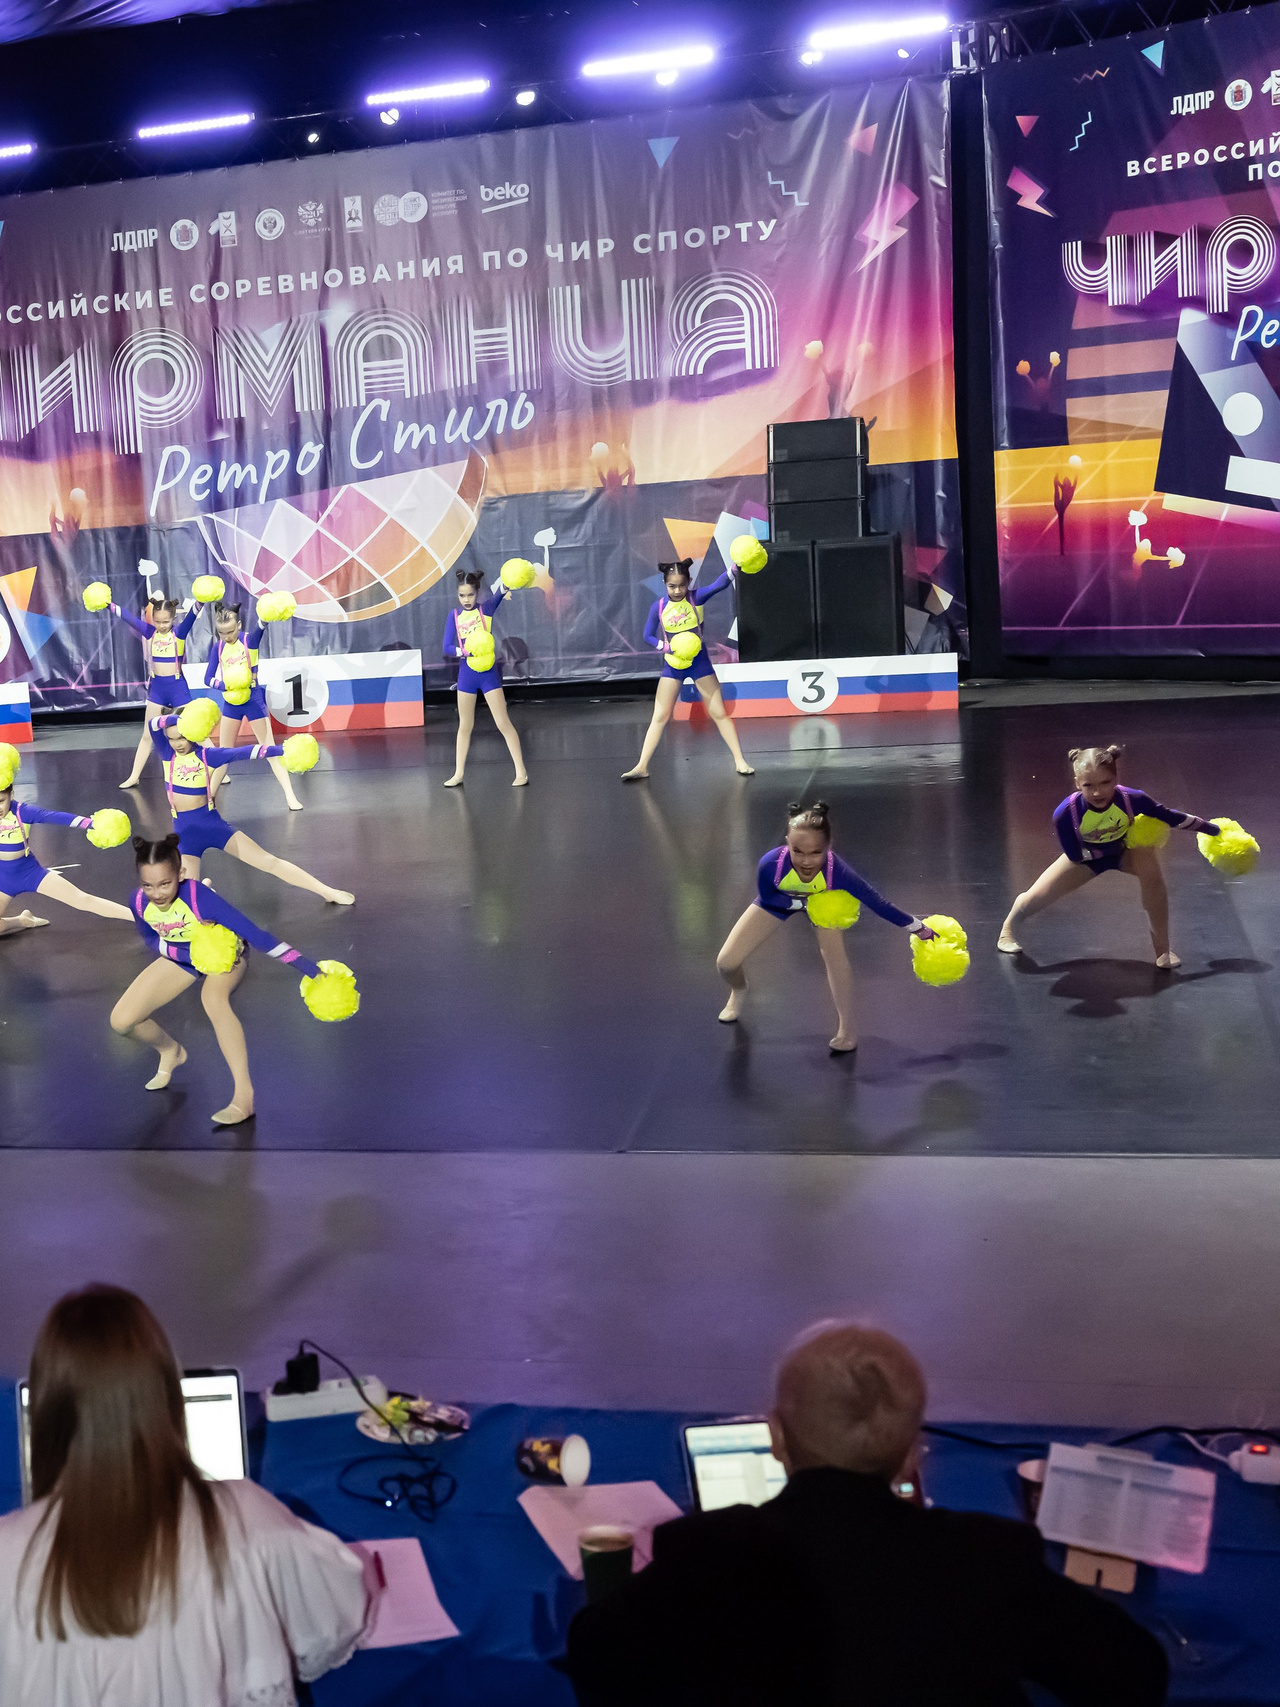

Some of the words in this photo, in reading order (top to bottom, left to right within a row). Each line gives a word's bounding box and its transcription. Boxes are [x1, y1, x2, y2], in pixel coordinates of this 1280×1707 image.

[1170, 90, 1214, 116] ЛДПР
[1127, 132, 1280, 177] ВСЕРОССИЙ
[480, 182, 530, 202] beko
[111, 229, 158, 253] ЛДПР
[190, 254, 464, 303] СОРЕВНОВАНИЯ
[482, 247, 528, 270] ПО
[546, 238, 616, 263] ЧИР
[634, 218, 778, 254] СПОРТУ
[150, 441, 325, 517] Ретро
[350, 393, 535, 470] Стиль
[285, 674, 309, 715] 1
[801, 672, 825, 703] 3
